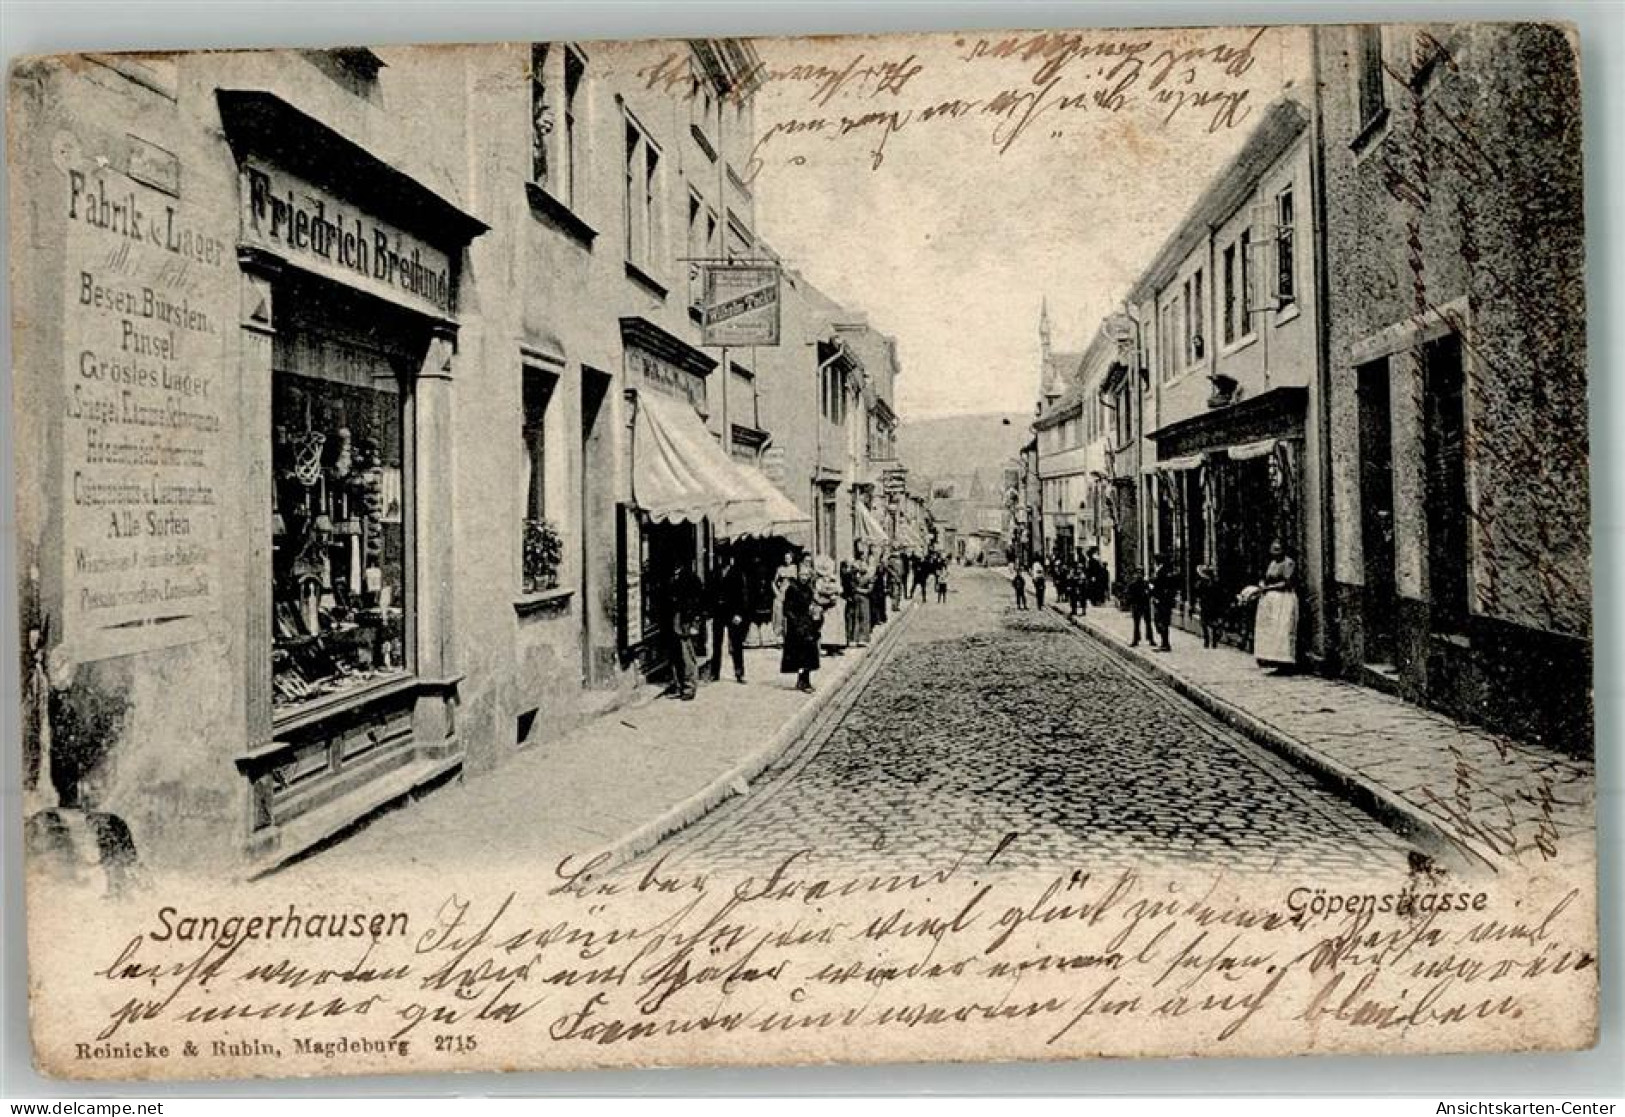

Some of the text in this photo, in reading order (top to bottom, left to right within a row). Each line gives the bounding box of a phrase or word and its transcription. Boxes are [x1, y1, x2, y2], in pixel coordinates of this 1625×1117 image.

[69, 169, 142, 241] Fabrik
[166, 206, 224, 267] Lager
[250, 166, 369, 277] Friedrich
[163, 364, 209, 397] Lager
[106, 509, 190, 538] Alle Sorten
[1286, 886, 1488, 921] Göpenstrasse
[150, 904, 409, 948] Sangerhausen
[75, 1034, 477, 1060] Reinicke & Rubin, Magdeburg 2715
